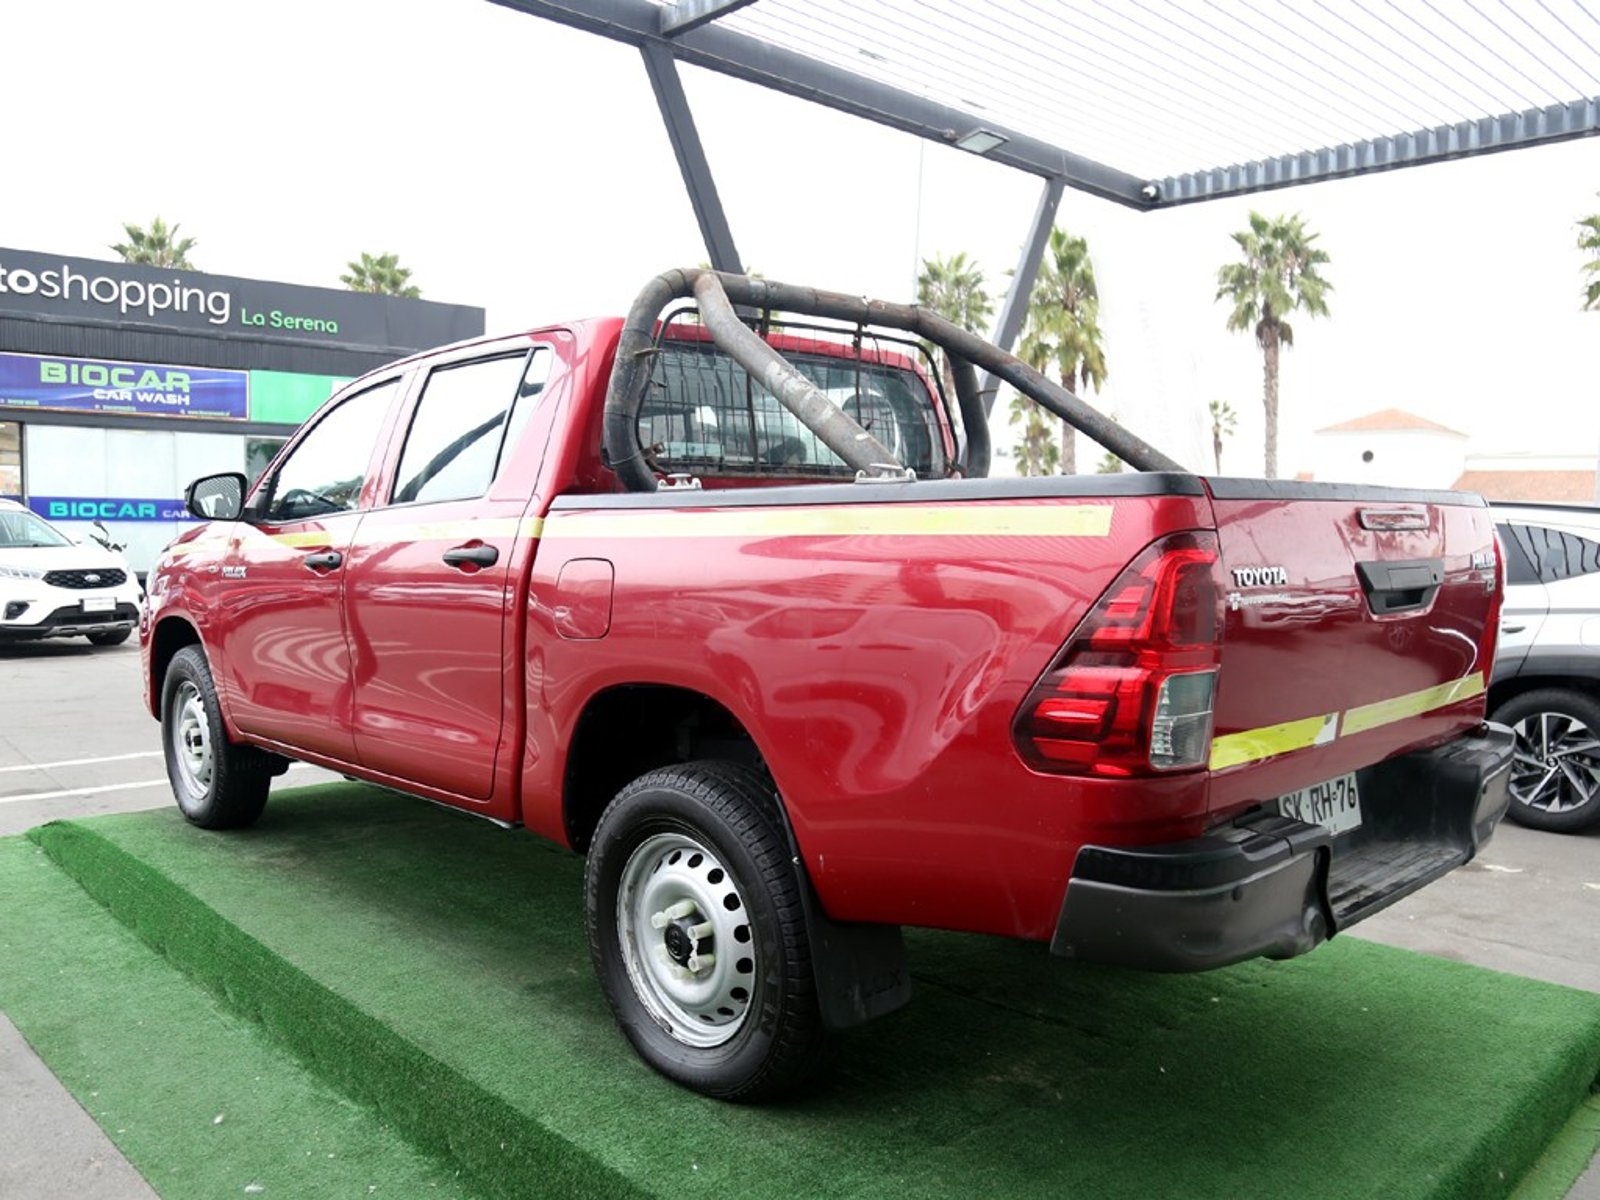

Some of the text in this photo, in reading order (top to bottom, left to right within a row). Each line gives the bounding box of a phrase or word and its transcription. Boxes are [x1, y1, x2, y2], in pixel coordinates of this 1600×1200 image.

[241, 307, 338, 333] La Serena
[40, 361, 191, 392] BIOCAR
[93, 388, 190, 406] CAR WASH
[49, 501, 190, 519] BIOCAR CAR
[1232, 566, 1287, 586] TOYOTA
